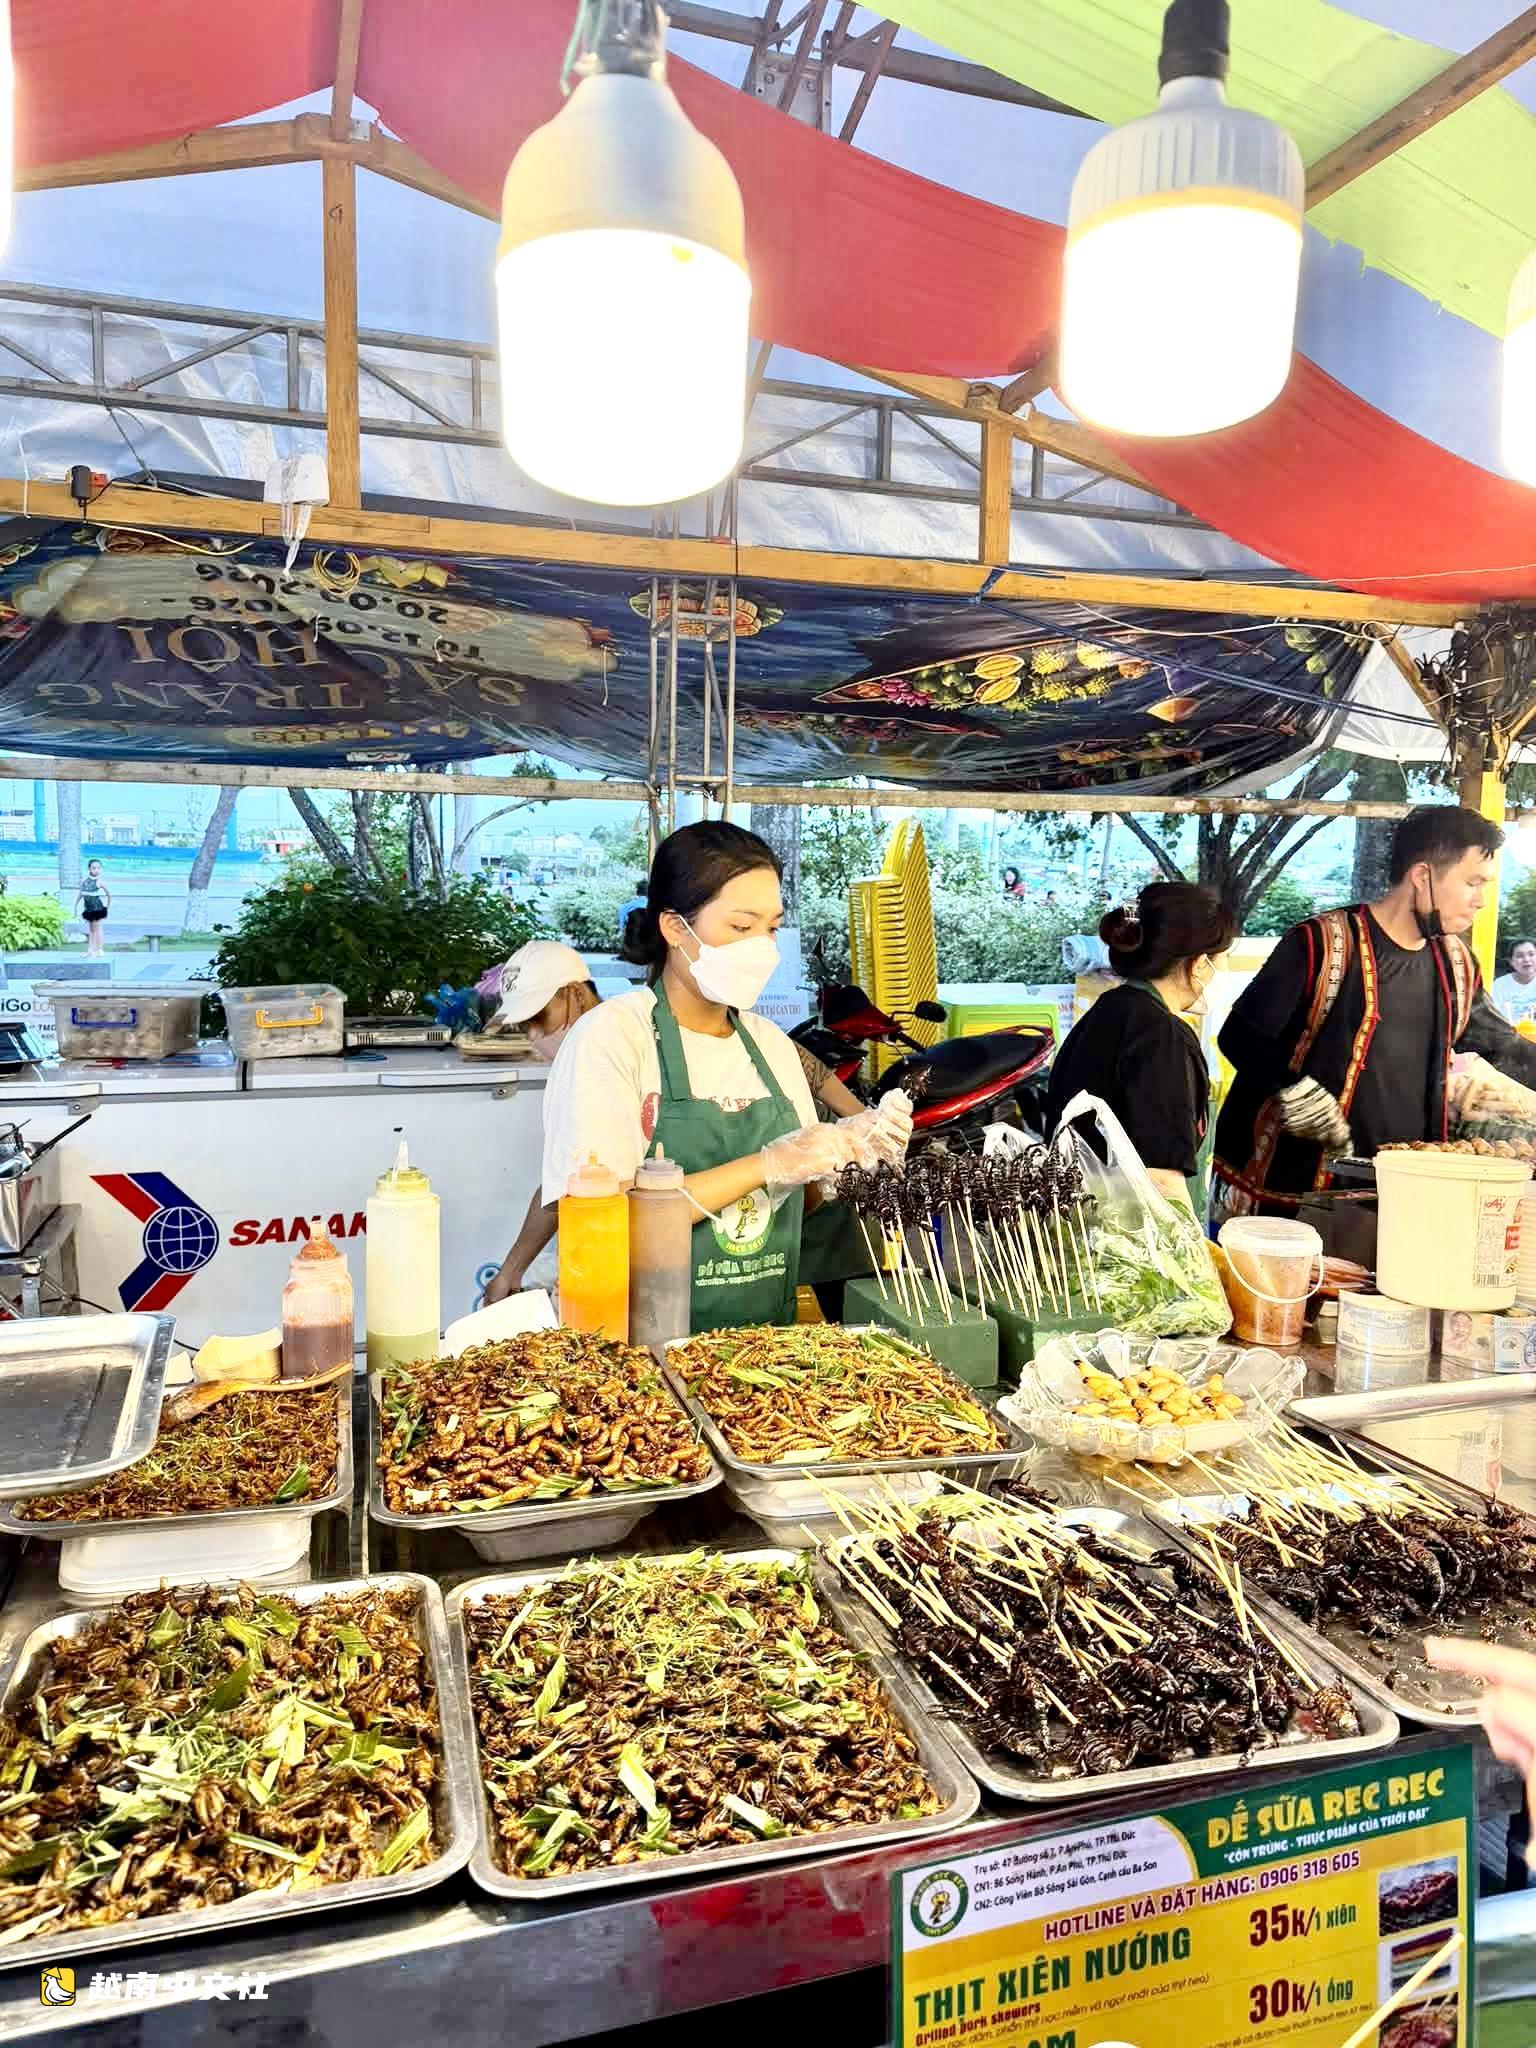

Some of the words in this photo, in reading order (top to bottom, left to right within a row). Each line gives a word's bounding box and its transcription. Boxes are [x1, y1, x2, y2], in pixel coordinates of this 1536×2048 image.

[116, 614, 331, 674] HỘI
[1207, 1799, 1248, 1849] DẾ
[1257, 1792, 1316, 1837] SỮA
[1322, 1781, 1380, 1821] REC
[1388, 1767, 1445, 1806] REC
[1045, 1905, 1125, 1940] HOTLINE
[1131, 1896, 1156, 1920] VÀ
[1160, 1887, 1197, 1917] ĐẶT
[1201, 1874, 1255, 1904] HÀNG:
[1260, 1864, 1298, 1888] 0906
[1303, 1857, 1328, 1879] 318
[1332, 1850, 1360, 1872] 605
[1326, 1903, 1356, 1928] xiên
[913, 1976, 985, 2027] THỊT
[997, 1954, 1071, 2004] XIÊN
[1085, 1926, 1191, 1982] NƯỚNG
[959, 2014, 987, 2035] pork
[991, 2002, 1041, 2025] skewers
